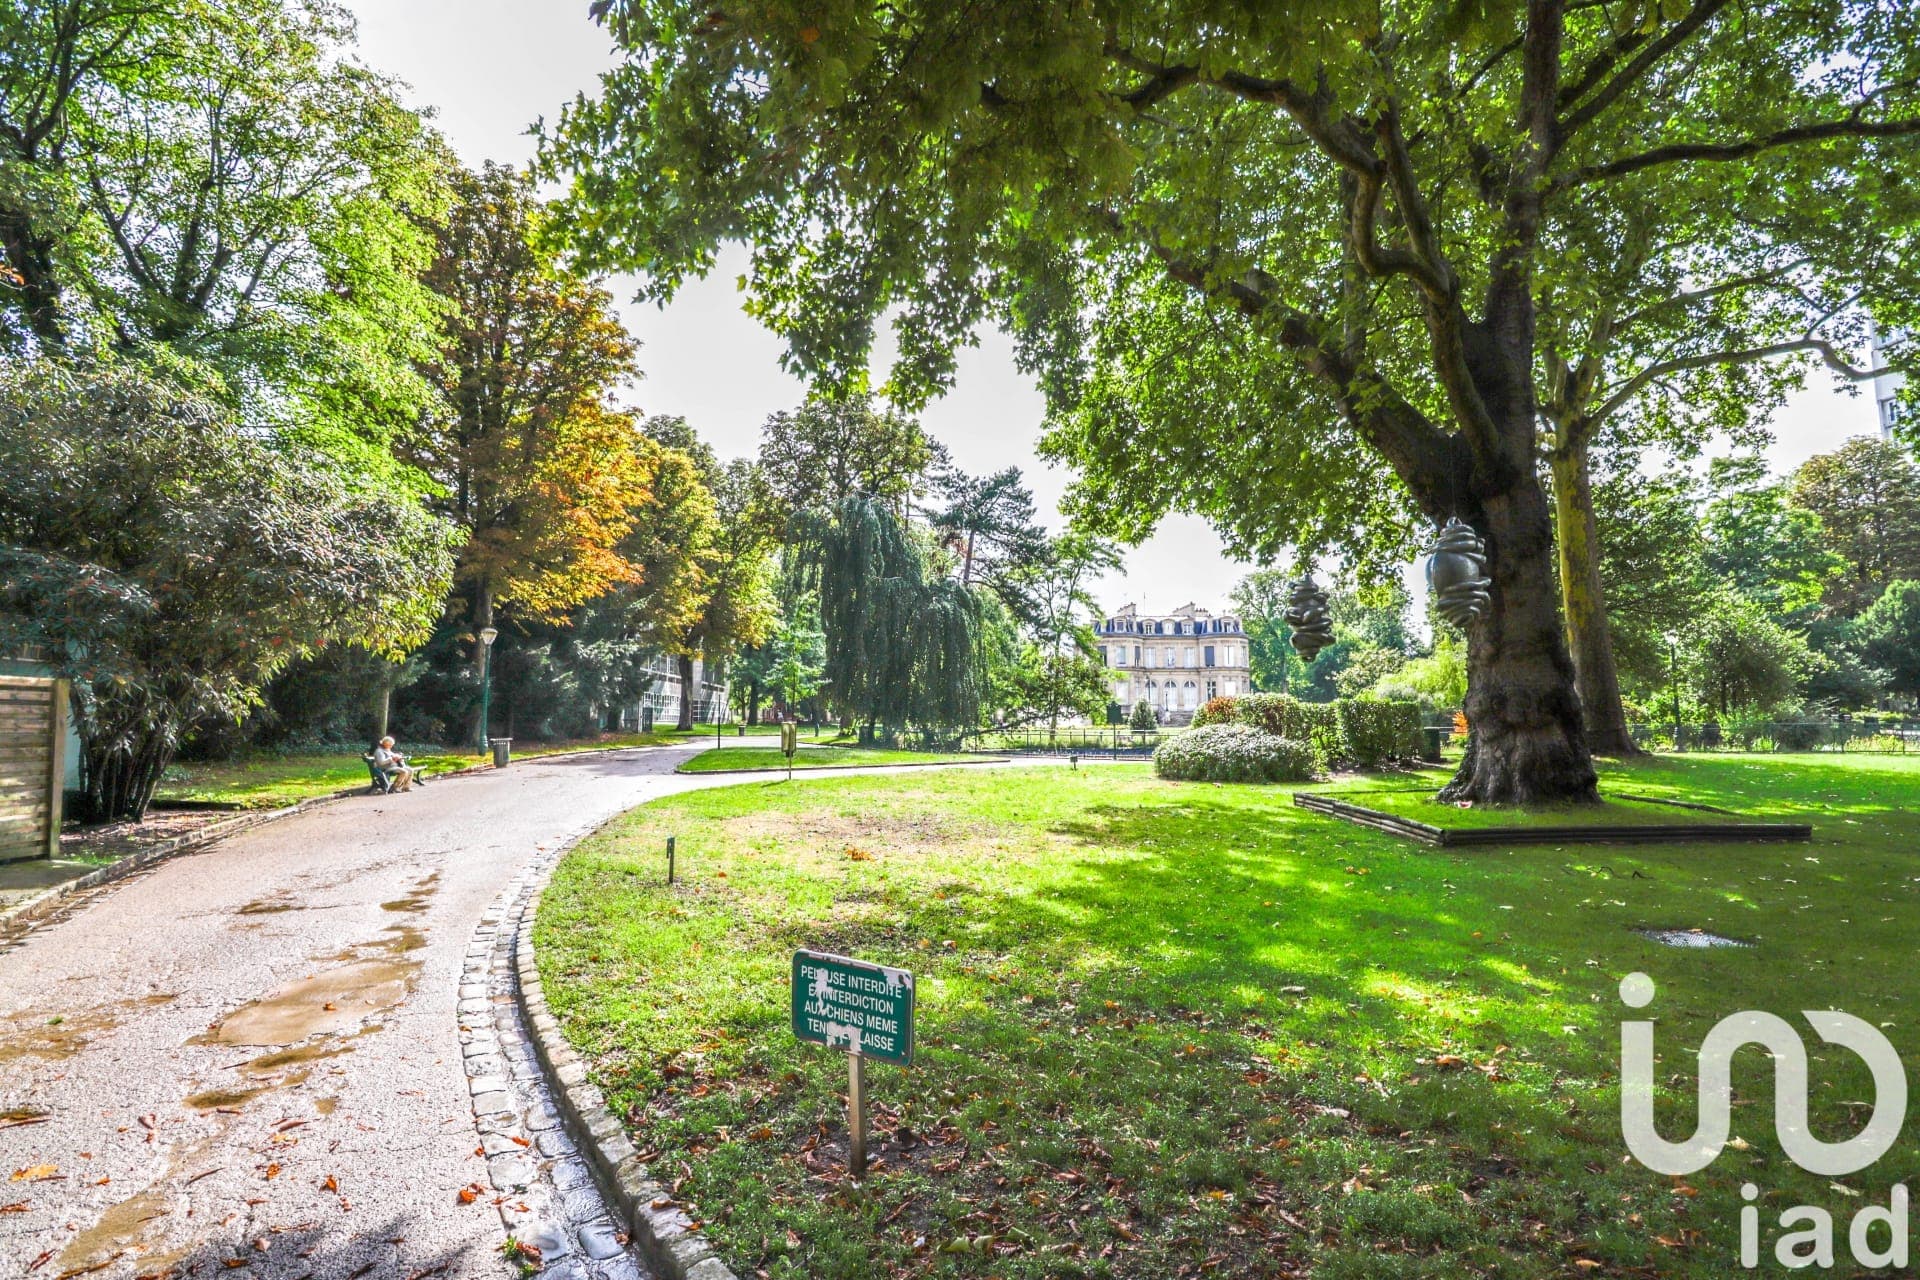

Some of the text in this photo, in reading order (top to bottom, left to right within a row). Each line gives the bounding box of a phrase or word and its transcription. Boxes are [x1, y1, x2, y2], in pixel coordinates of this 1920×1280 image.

[801, 965, 846, 986] PELUSE
[827, 1004, 864, 1026] CHIENS
[866, 1014, 898, 1034] MEME
